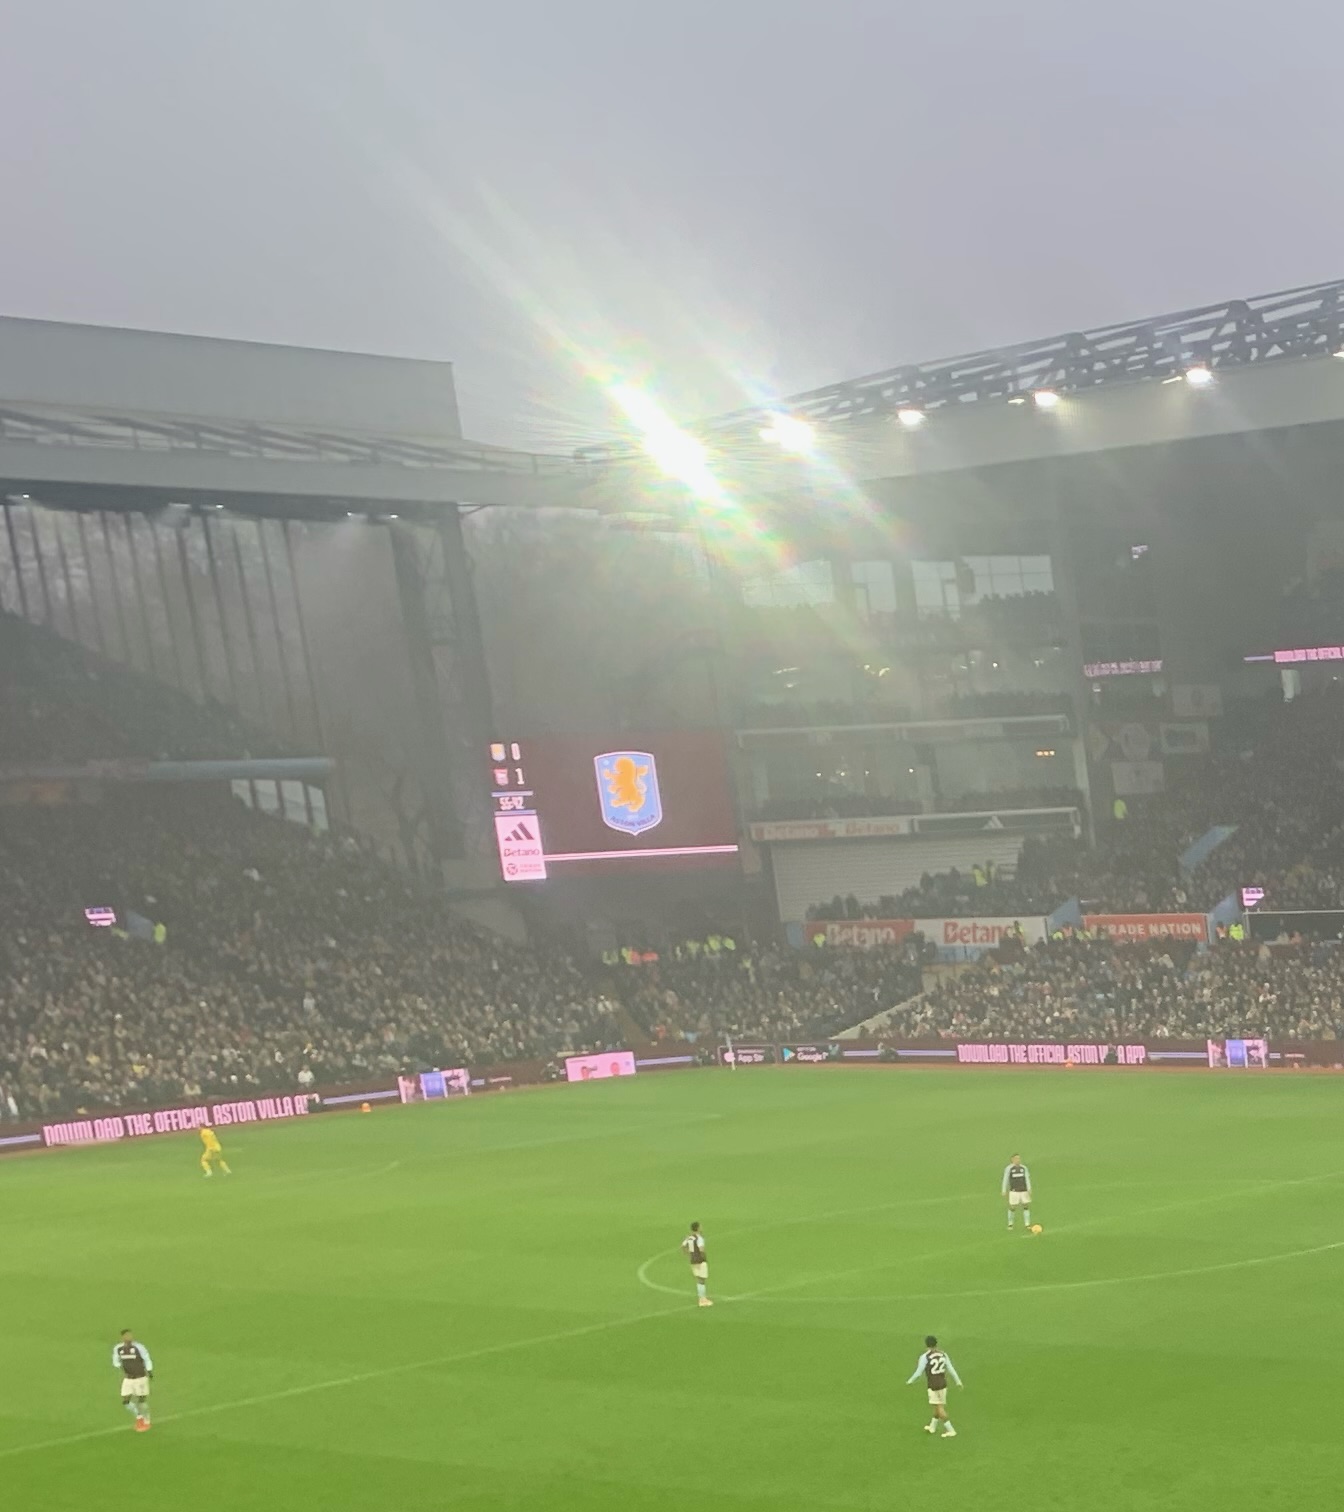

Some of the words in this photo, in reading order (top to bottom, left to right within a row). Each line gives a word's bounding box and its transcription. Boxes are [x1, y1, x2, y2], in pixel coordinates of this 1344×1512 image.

[515, 768, 525, 785] 1
[1008, 1044, 1027, 1063] THE
[125, 1113, 153, 1137] THE
[154, 1107, 213, 1133] OFFICIAL
[213, 1101, 258, 1126] ASTON
[258, 1096, 297, 1122] VILLA
[930, 1356, 946, 1375] 22
